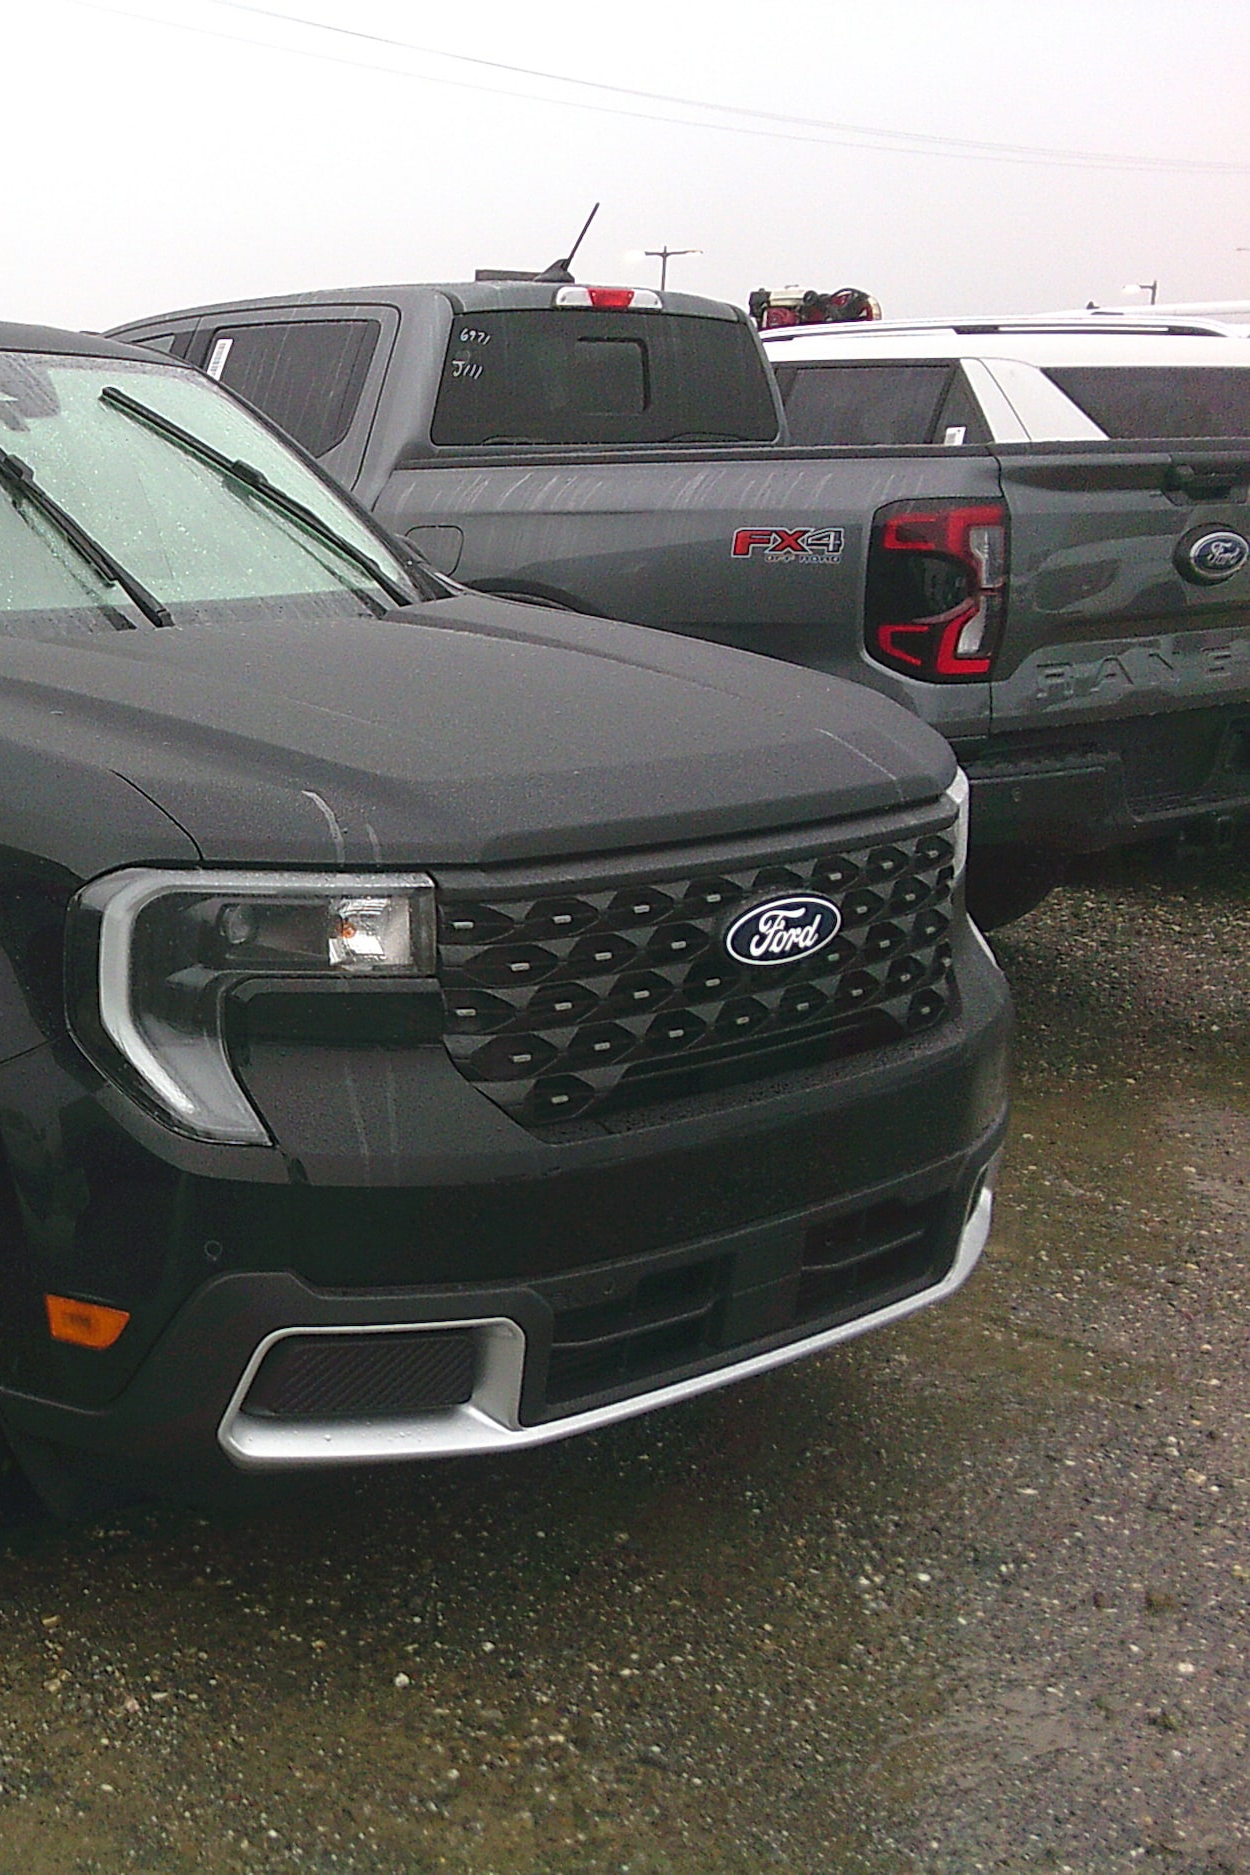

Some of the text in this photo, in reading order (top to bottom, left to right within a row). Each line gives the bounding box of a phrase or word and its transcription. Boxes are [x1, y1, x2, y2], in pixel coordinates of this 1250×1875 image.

[460, 327, 491, 345] 6971
[731, 527, 845, 558] FX4
[1206, 541, 1242, 565] Ford
[749, 906, 823, 957] Ford
